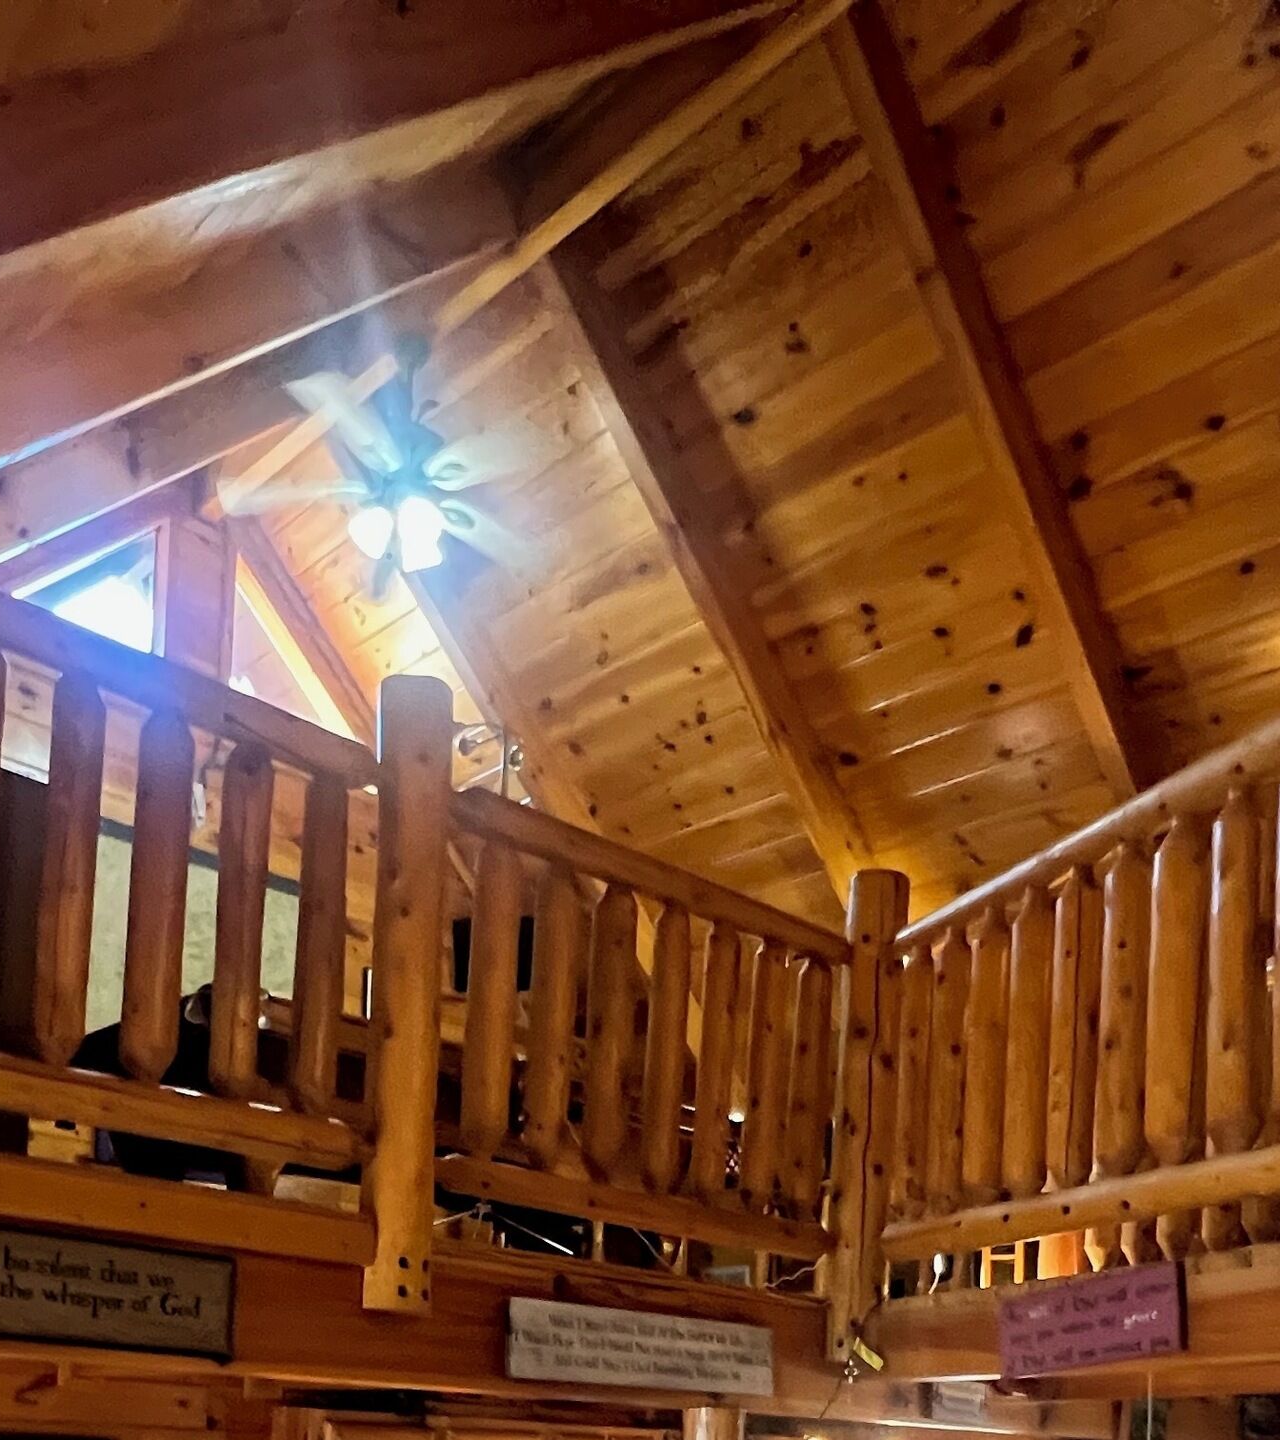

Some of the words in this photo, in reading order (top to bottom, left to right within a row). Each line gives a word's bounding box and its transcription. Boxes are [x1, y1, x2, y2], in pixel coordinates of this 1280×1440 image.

[99, 1259, 139, 1285] that
[0, 1273, 35, 1300] the
[41, 1281, 125, 1319] whisper
[130, 1293, 155, 1313] of
[159, 1290, 202, 1319] God
